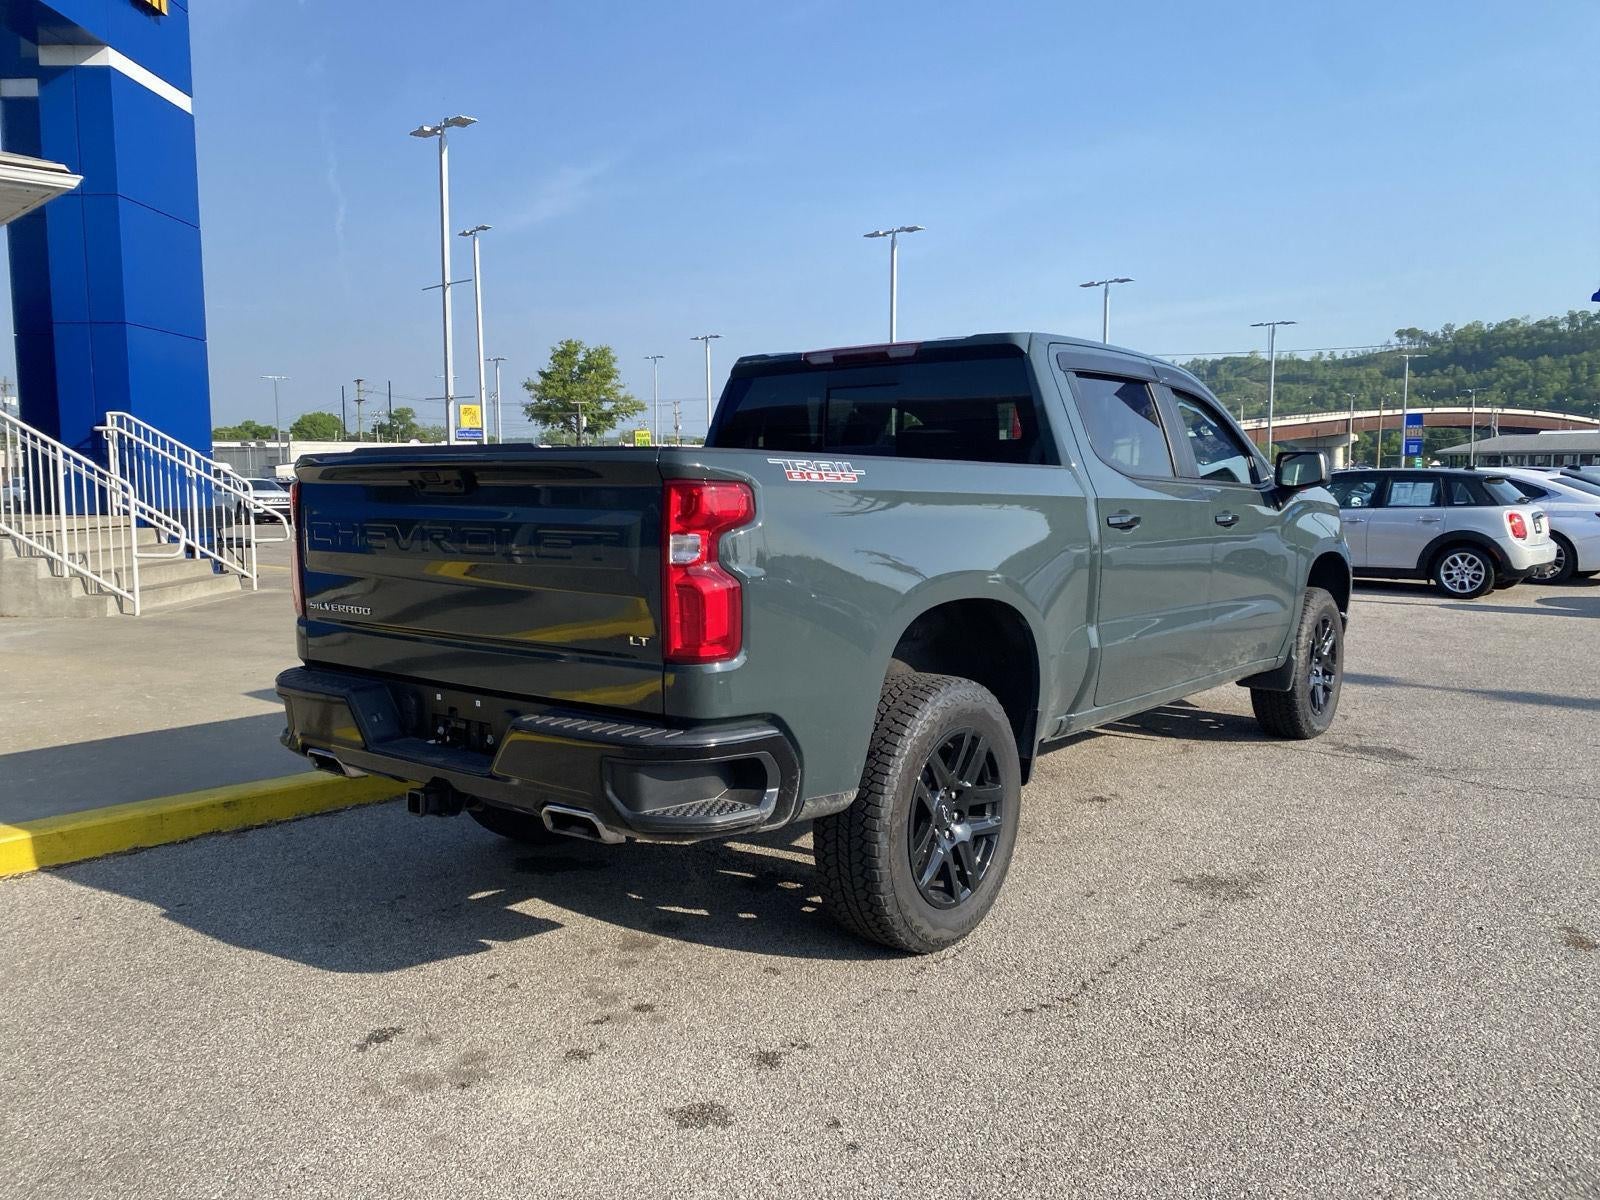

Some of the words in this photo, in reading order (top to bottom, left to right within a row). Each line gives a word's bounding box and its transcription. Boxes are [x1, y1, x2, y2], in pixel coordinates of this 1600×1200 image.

[767, 458, 866, 475] TRAIL
[786, 470, 858, 483] BOSS
[311, 521, 620, 561] CHEVROLET
[309, 602, 371, 615] SILVERADO
[628, 635, 650, 647] LT
